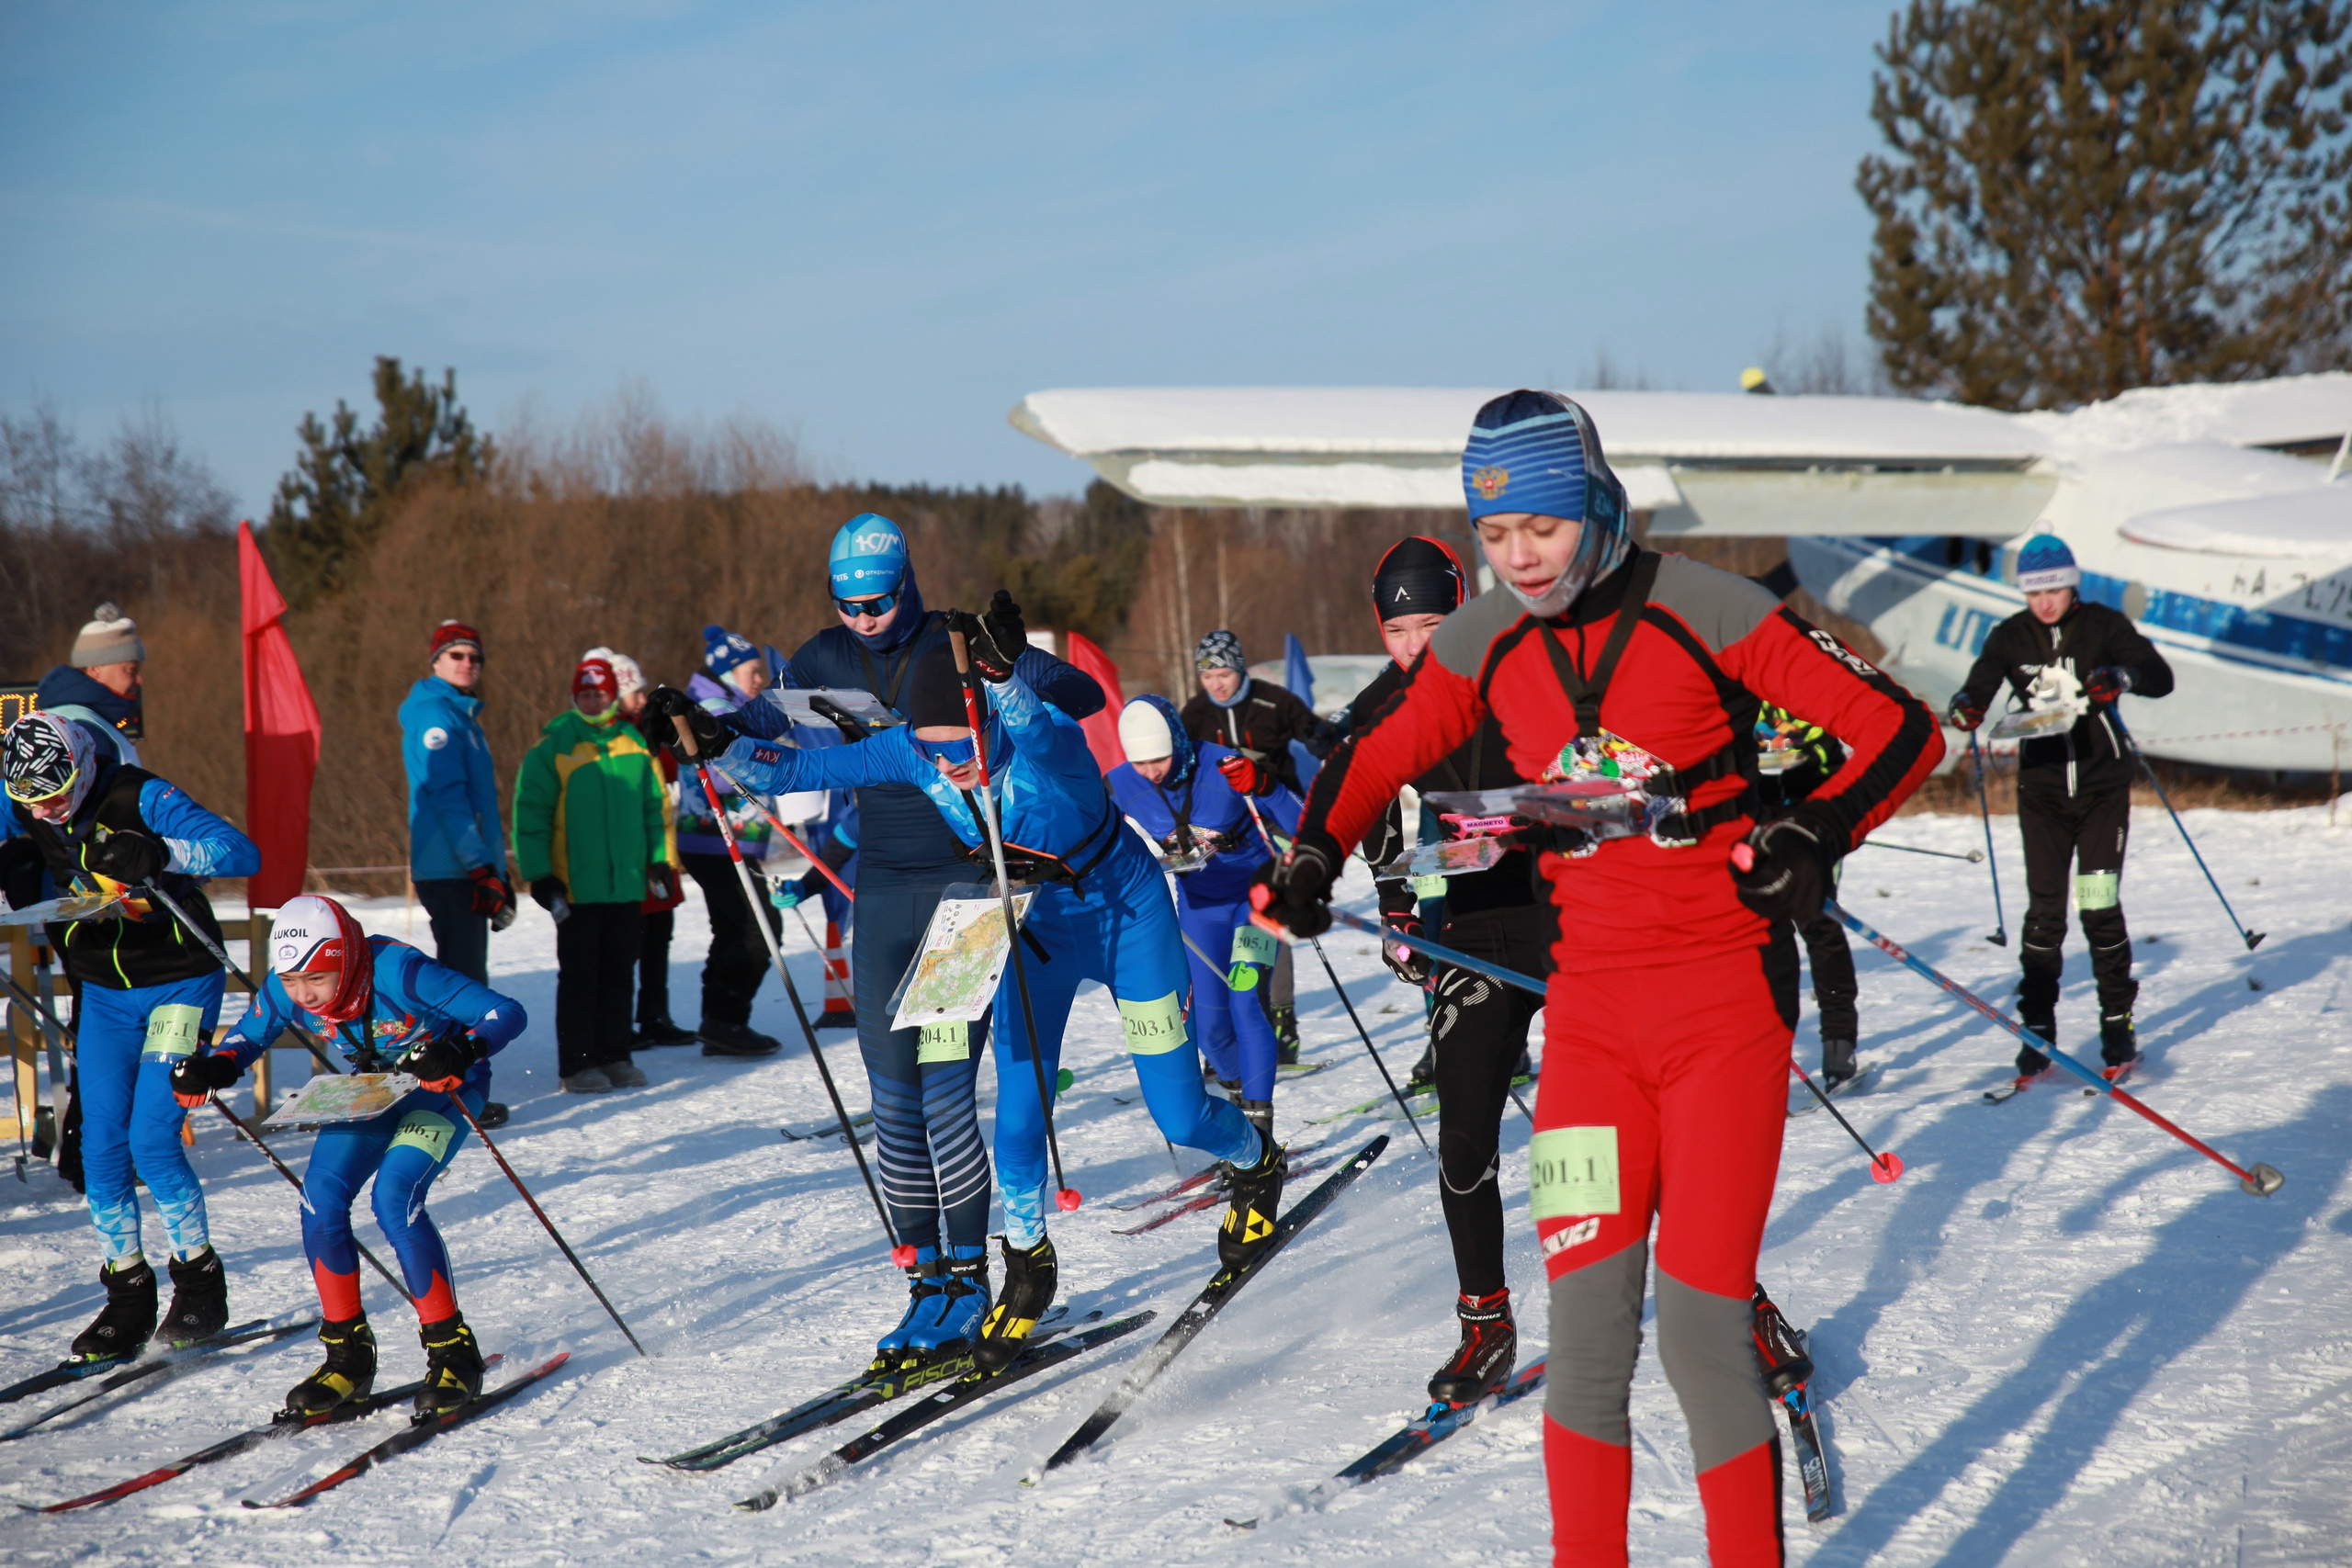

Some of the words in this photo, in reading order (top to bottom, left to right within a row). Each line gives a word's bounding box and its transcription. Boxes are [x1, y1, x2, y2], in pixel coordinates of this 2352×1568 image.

[755, 749, 781, 763] KV+
[1466, 819, 1504, 828] MAGNETO
[274, 928, 309, 941] LUKOIL
[1237, 936, 1270, 952] 205.1
[147, 1020, 189, 1037] 207.1
[1129, 1014, 1175, 1037] 203.1
[920, 1026, 957, 1046] 204.1
[394, 1122, 441, 1144] 206.1
[1532, 1156, 1599, 1190] 201.1
[951, 1264, 978, 1273] SPINE
[319, 1335, 345, 1345] FISCHER
[426, 1337, 461, 1348] FISCHER
[902, 1354, 975, 1393] FISCH
